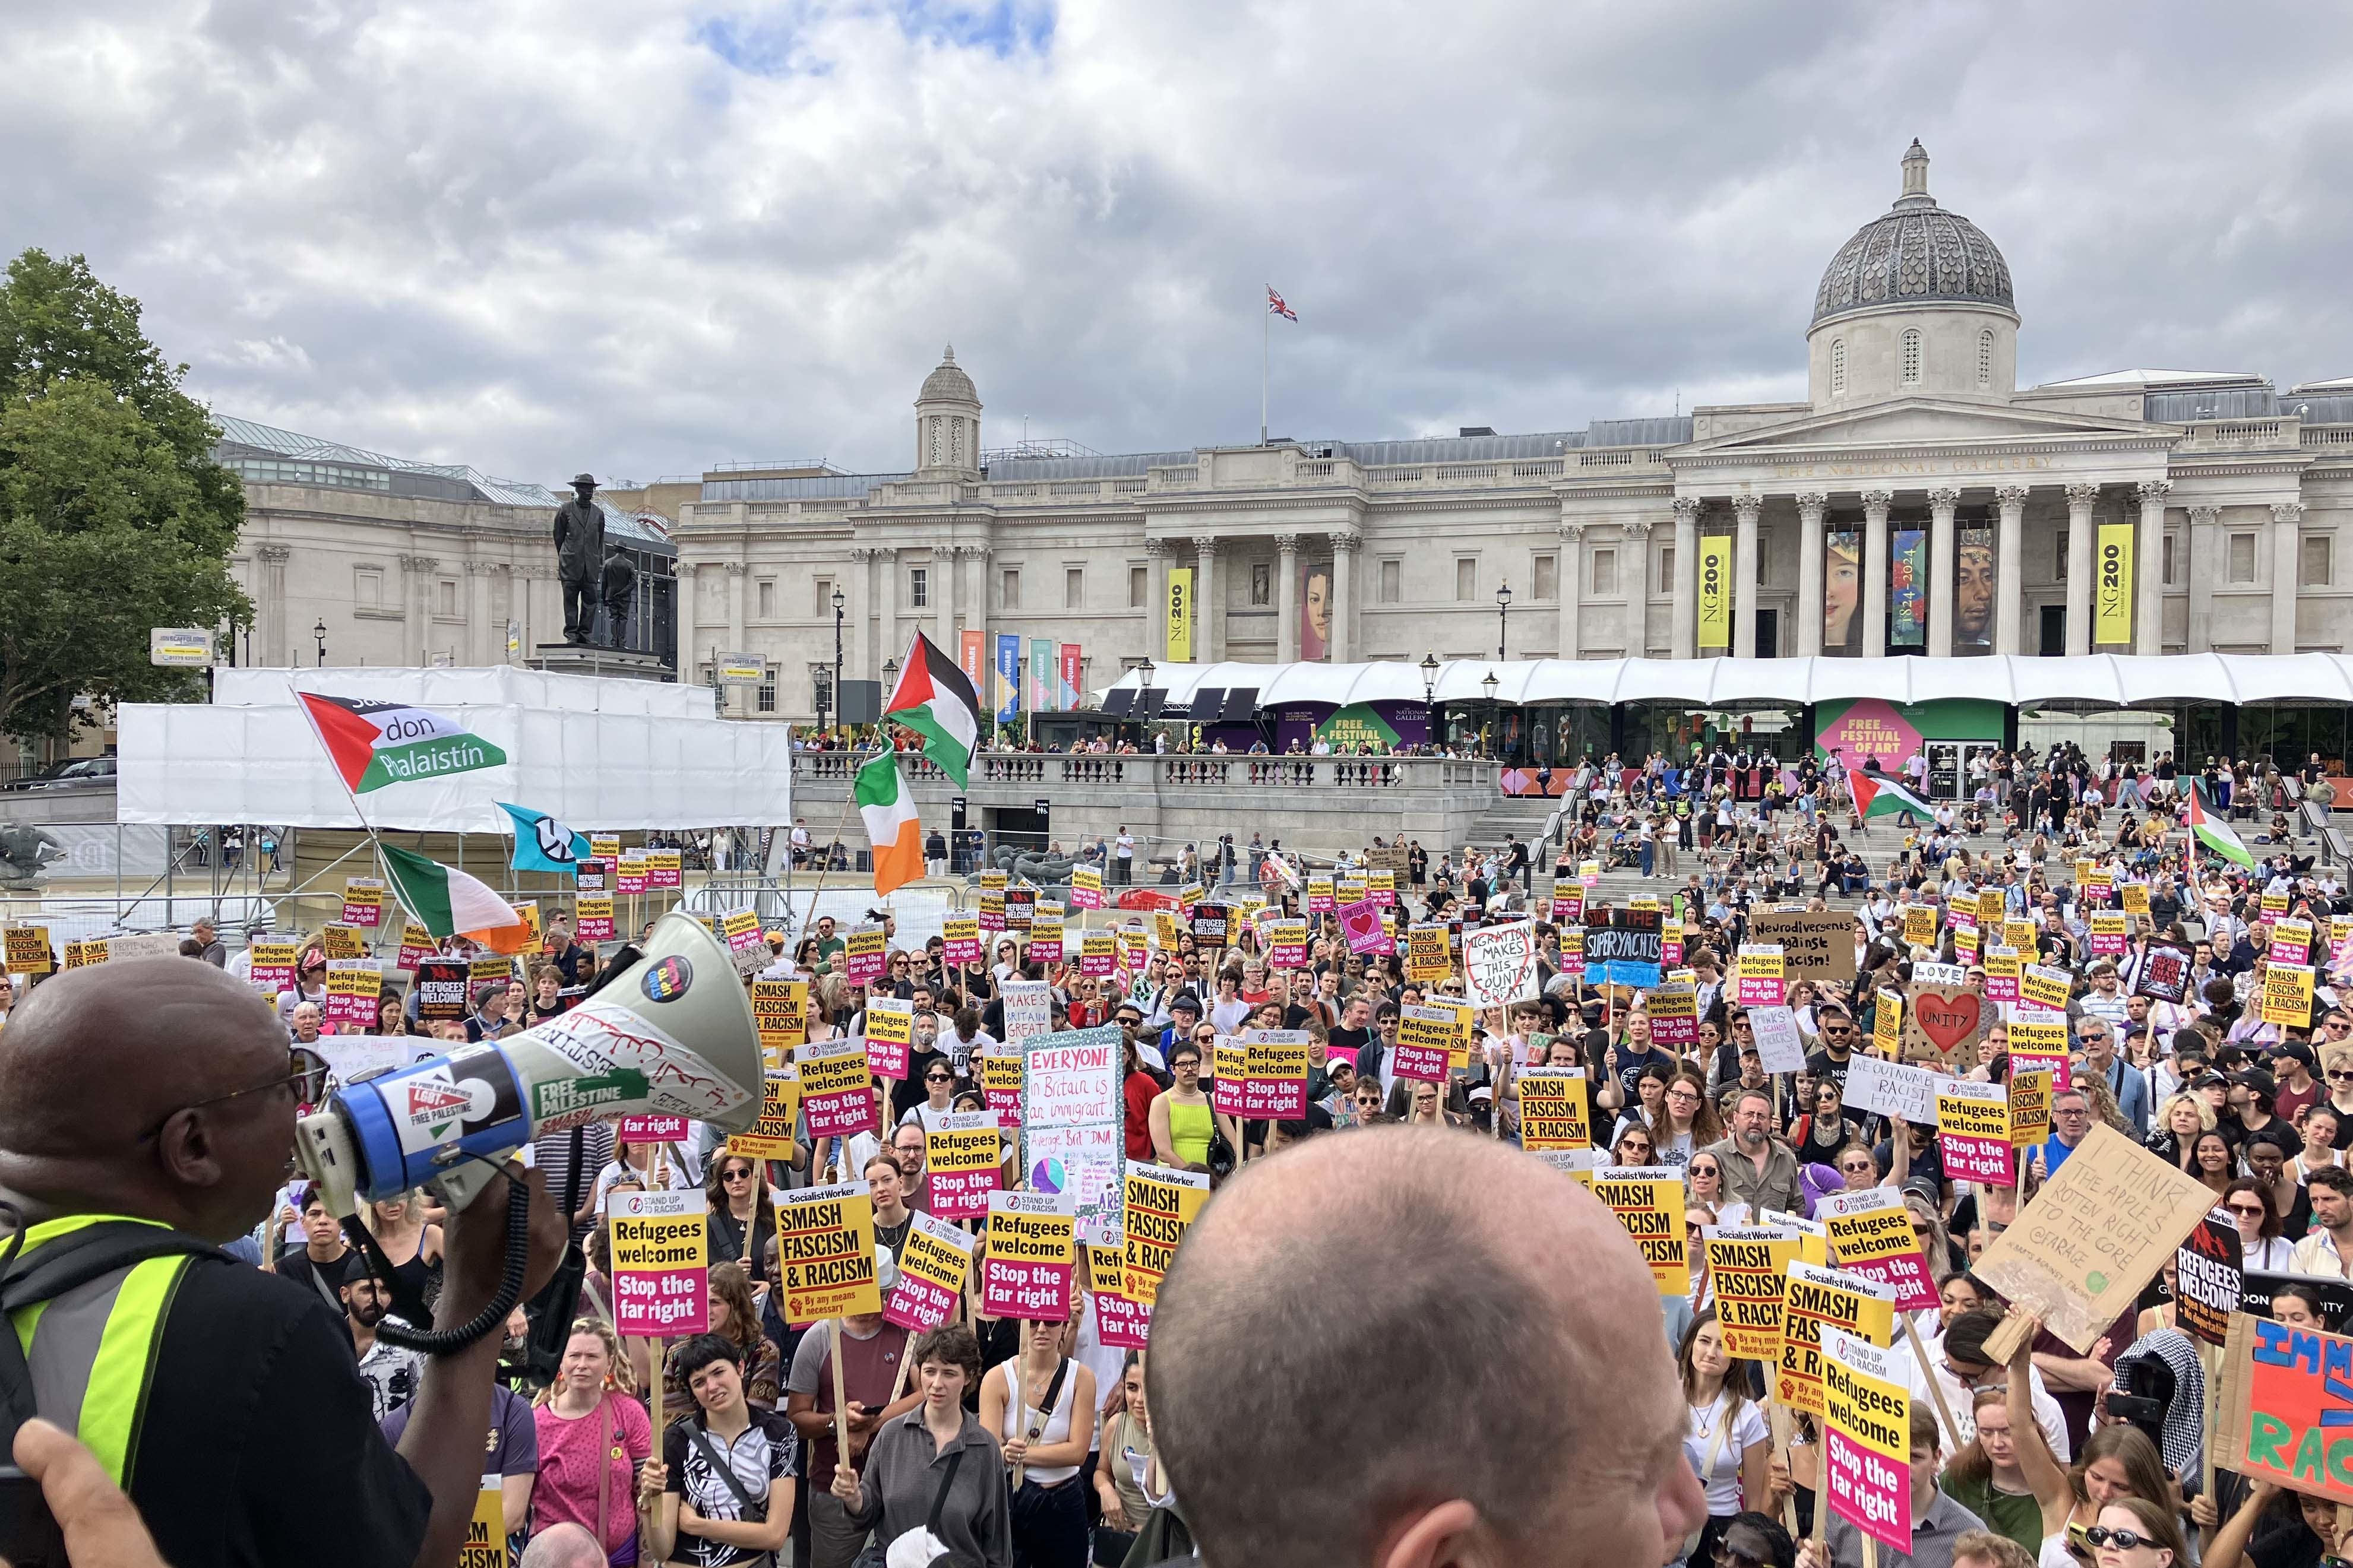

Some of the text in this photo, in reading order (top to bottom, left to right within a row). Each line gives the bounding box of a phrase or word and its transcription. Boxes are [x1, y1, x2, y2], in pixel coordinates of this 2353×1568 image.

[1775, 457, 2053, 476] THE NATIONAL GALLERY
[1704, 555, 1718, 622] NG200
[2103, 544, 2119, 617] NG200
[1171, 585, 1182, 641] NG200
[386, 716, 435, 741] don
[1336, 720, 1362, 729] FREE
[1848, 719, 1880, 730] FREE
[1329, 730, 1380, 740] FESTIVAL
[1840, 731, 1900, 742] FESTIVAL
[1855, 742, 1872, 753] OF
[1875, 742, 1900, 753] ART
[379, 743, 485, 777] Phalaistín
[1342, 902, 1372, 920] UNITED IN
[1587, 909, 1654, 926] STOP THE
[591, 927, 609, 936] right
[1465, 926, 1530, 948] MIGRATION
[1755, 921, 1851, 936] Neurodivergents
[1351, 931, 1383, 949] DIVERSITY
[1587, 932, 1662, 958] SUPERYACHTS
[736, 942, 771, 959] LONDON
[1483, 941, 1523, 959] MAKES
[1485, 961, 1510, 976] THIS
[1786, 954, 1830, 967] acism!
[2155, 956, 2181, 966] MORE
[658, 968, 668, 981] TO
[1473, 965, 1533, 990] COUNTRY
[1915, 967, 1961, 980] LOVE
[2152, 968, 2178, 979] THAN
[2268, 970, 2298, 983] SMASH
[420, 982, 465, 993] REFUGEES
[648, 971, 662, 1000] STAND
[660, 982, 672, 996] UP
[1481, 984, 1524, 1003] GREAT
[2267, 983, 2304, 997] FASCISM
[420, 993, 464, 1003] WELCOME
[1005, 994, 1045, 1007] MAKES
[2265, 997, 2308, 1011] & RACISM
[1007, 1012, 1045, 1021] BRITAIN
[1754, 1012, 1785, 1025] PUNKS
[1924, 1012, 1968, 1028] UNITY
[1007, 1023, 1045, 1037] GREAT
[1764, 1024, 1786, 1032] AGAINST
[1761, 1032, 1792, 1046] PRICKS
[801, 1057, 865, 1078] Refugees
[1032, 1048, 1109, 1070] EVERYONE
[1853, 1059, 1870, 1072] WE
[539, 1079, 576, 1100] FREE
[804, 1074, 865, 1092] welcome
[1030, 1076, 1108, 1098] in Britain is
[1879, 1079, 1930, 1101] RACIST
[540, 1087, 622, 1116] PALESTINE
[808, 1094, 866, 1117] Stop the
[1029, 1093, 1112, 1122] an immigrant!
[1871, 1092, 1925, 1117] HATE!
[410, 1102, 472, 1126] FREE PALESTINE
[809, 1110, 868, 1128] far right
[1031, 1133, 1061, 1154] Average
[2115, 1149, 2193, 1214] THINK
[644, 1197, 667, 1205] STAND
[1099, 1192, 1120, 1211] ARE
[2072, 1161, 2167, 1234] THE APPLES
[656, 1204, 685, 1213] RACISM
[780, 1203, 842, 1231] SMASH
[2051, 1180, 2155, 1255] ROTTEN RIGHT
[616, 1221, 701, 1245] Refugees
[992, 1215, 1070, 1239] Refugees
[2038, 1200, 2133, 1272] TO THE CORE
[783, 1230, 859, 1259] FASCISM
[992, 1237, 1065, 1256] welcome
[2030, 1226, 2088, 1268] @FARAGE
[618, 1246, 697, 1263] welcome
[787, 1257, 872, 1287] & RACISM
[989, 1262, 1060, 1285] Stop the
[2178, 1247, 2241, 1292] REFUGEES
[618, 1274, 695, 1299] Stop the
[2178, 1269, 2240, 1312] WELCOME
[805, 1291, 855, 1305] By any means
[988, 1288, 1059, 1307] far right
[619, 1296, 694, 1324] far right
[806, 1303, 844, 1315] necessary
[1827, 1361, 1905, 1418] Refugees
[1828, 1399, 1900, 1448] welcome
[1830, 1435, 1897, 1491] Stop the
[1830, 1469, 1858, 1500] far
[1854, 1487, 1898, 1526] right
